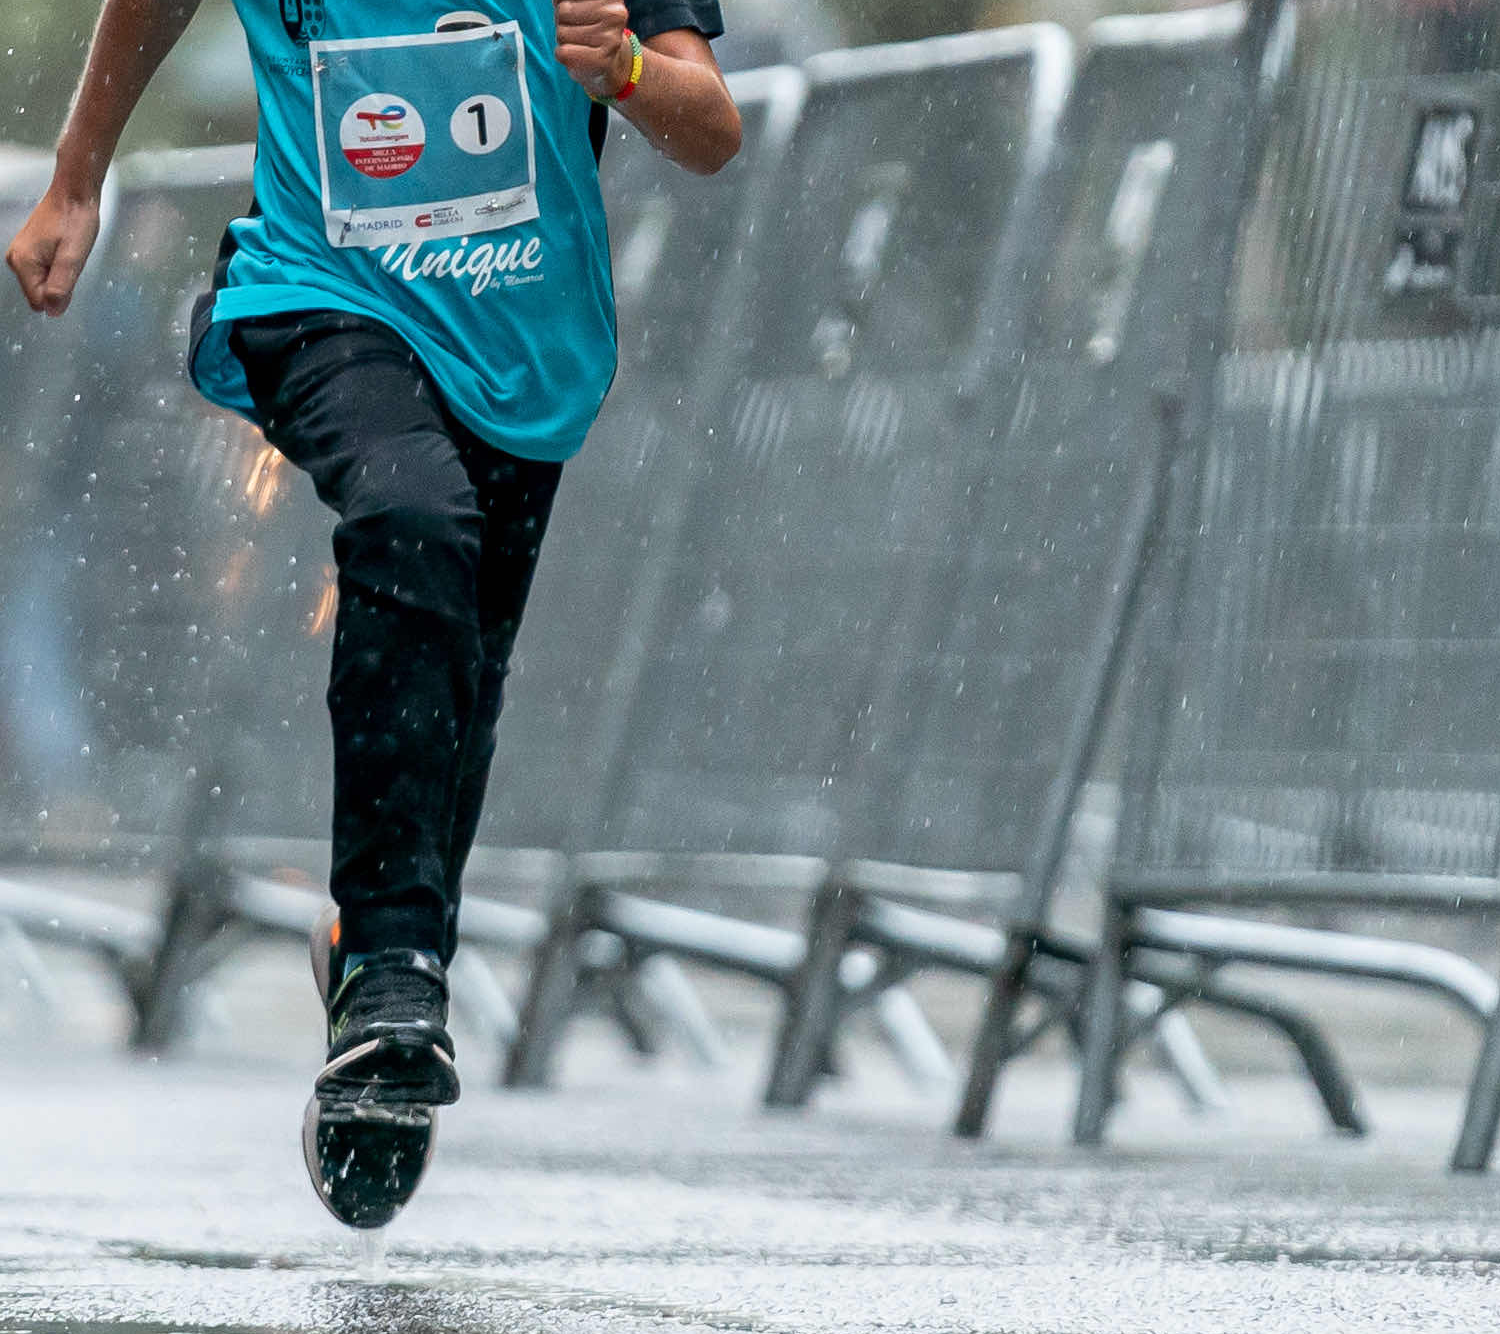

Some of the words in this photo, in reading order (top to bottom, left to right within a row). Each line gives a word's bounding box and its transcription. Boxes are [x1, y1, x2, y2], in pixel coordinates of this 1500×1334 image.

[467, 102, 488, 146] 1
[356, 219, 403, 232] MADRID
[369, 237, 543, 297] Unique
